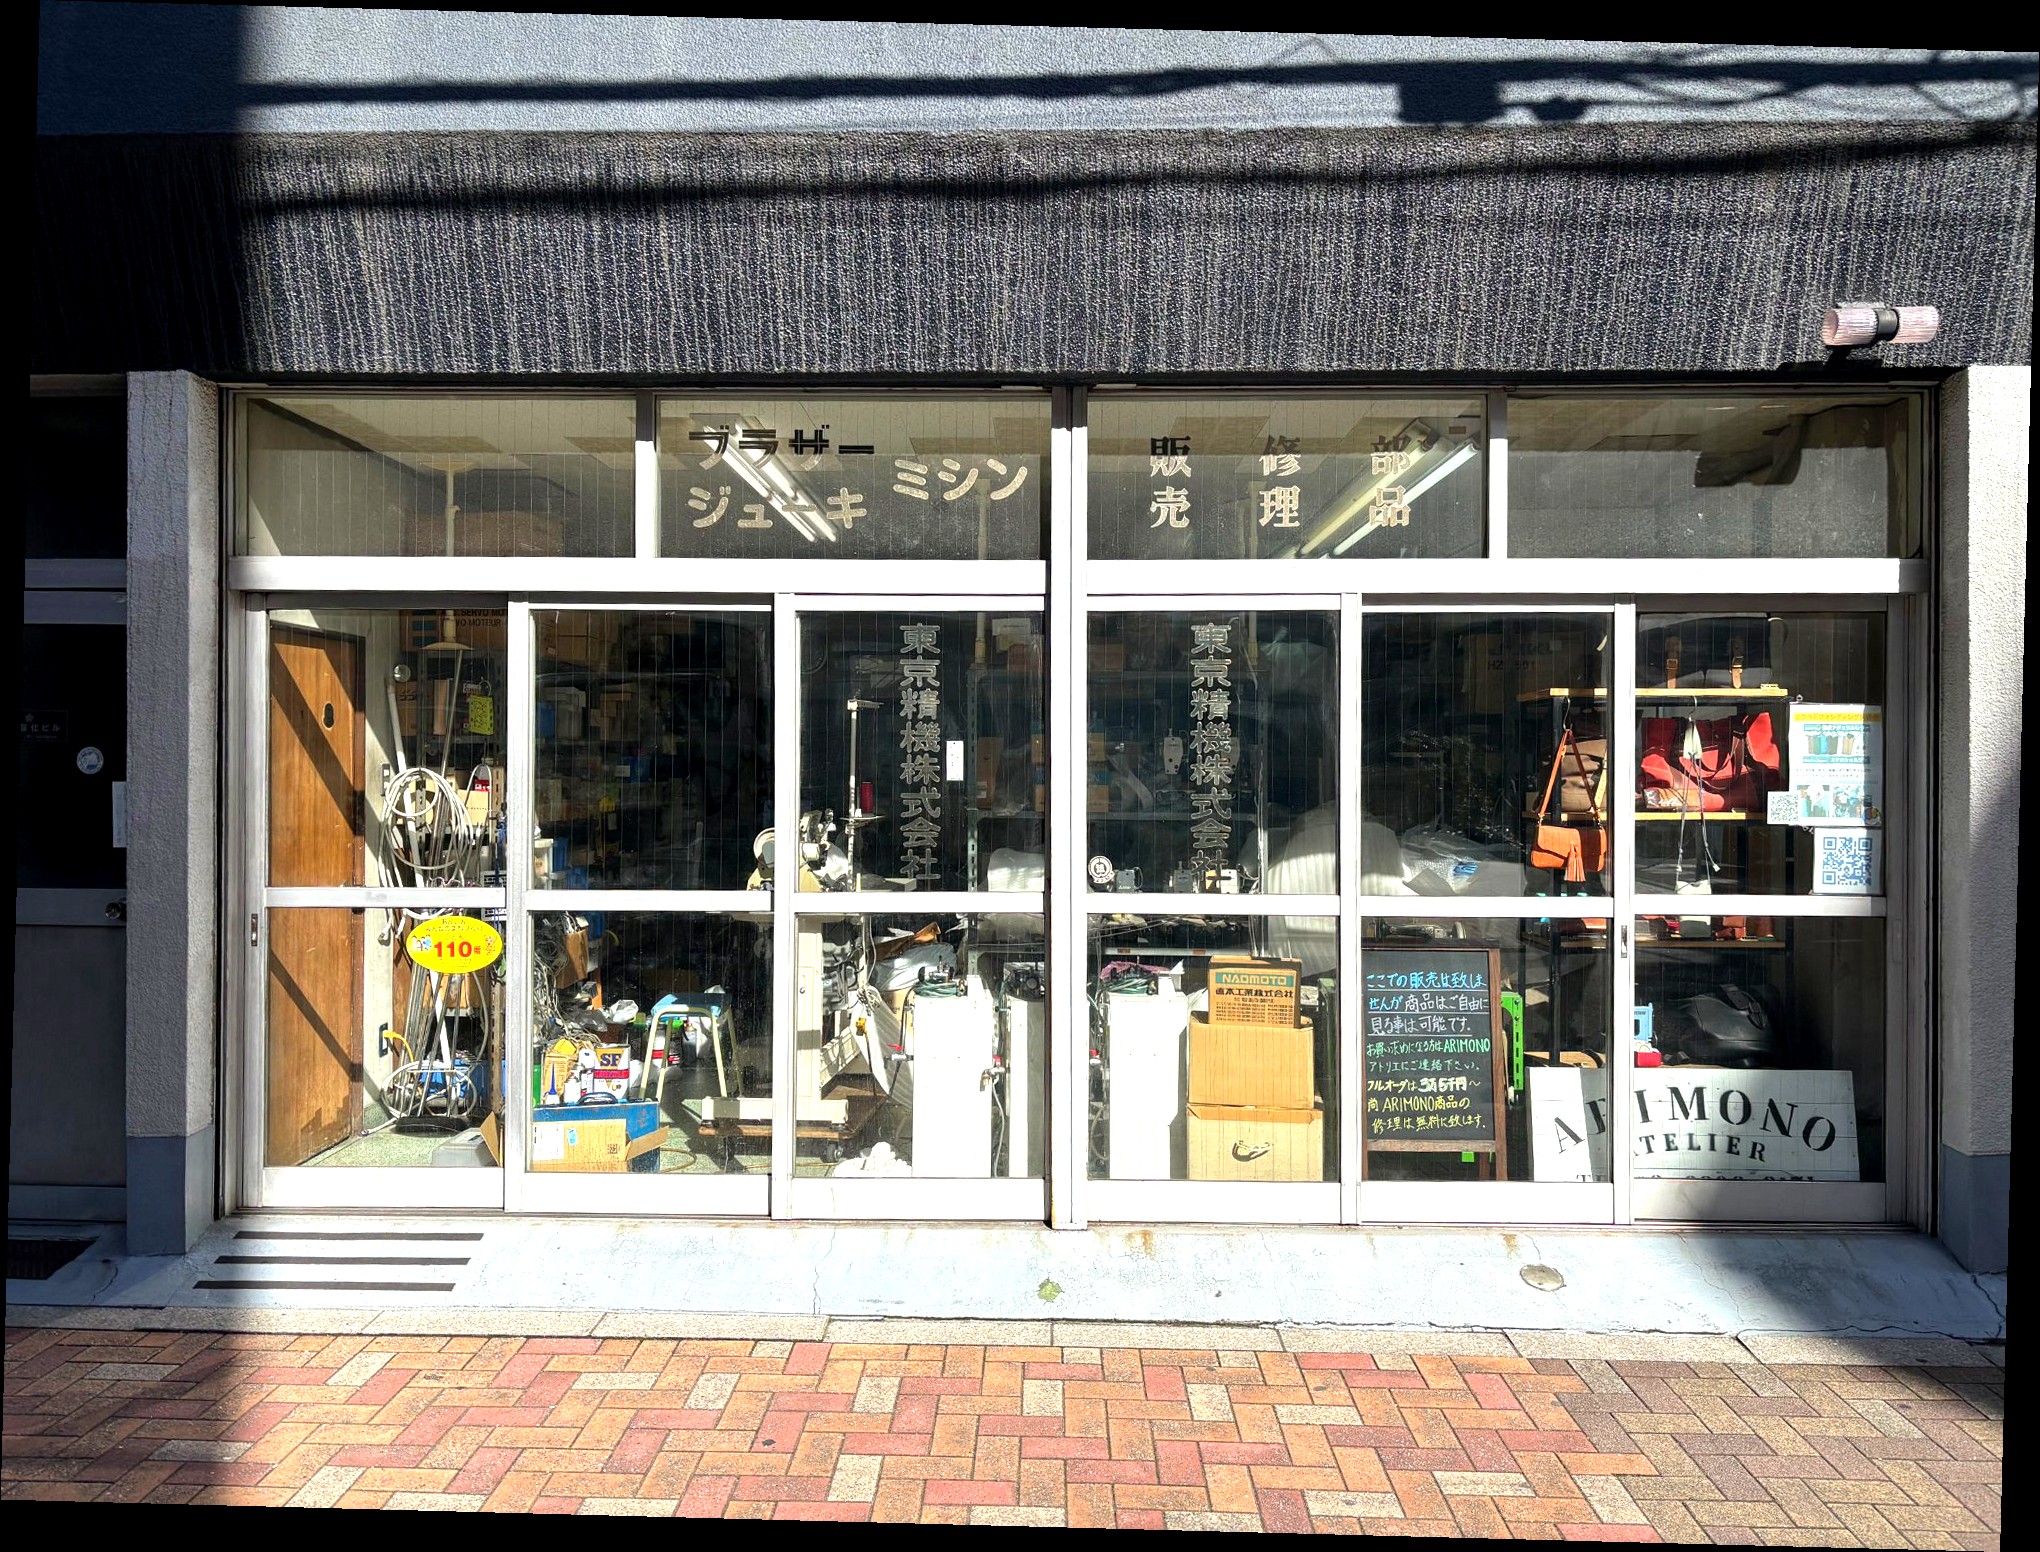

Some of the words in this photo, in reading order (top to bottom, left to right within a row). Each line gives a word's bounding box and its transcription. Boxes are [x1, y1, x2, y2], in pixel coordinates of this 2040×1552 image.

[688, 424, 875, 471] ブラザー
[893, 457, 1029, 501] ミシン
[1149, 435, 1193, 528] 販売
[1258, 434, 1301, 528] 修理
[1369, 434, 1412, 528] 部品
[687, 486, 868, 529] ジューキ
[899, 622, 942, 880] 東京精機株式会社
[1189, 622, 1232, 881] 東京精機株式会社
[1222, 973, 1287, 986] NAOMOTO
[1366, 971, 1487, 989] ここでの販売は致しま
[1633, 1132, 1767, 1163] TELIER
